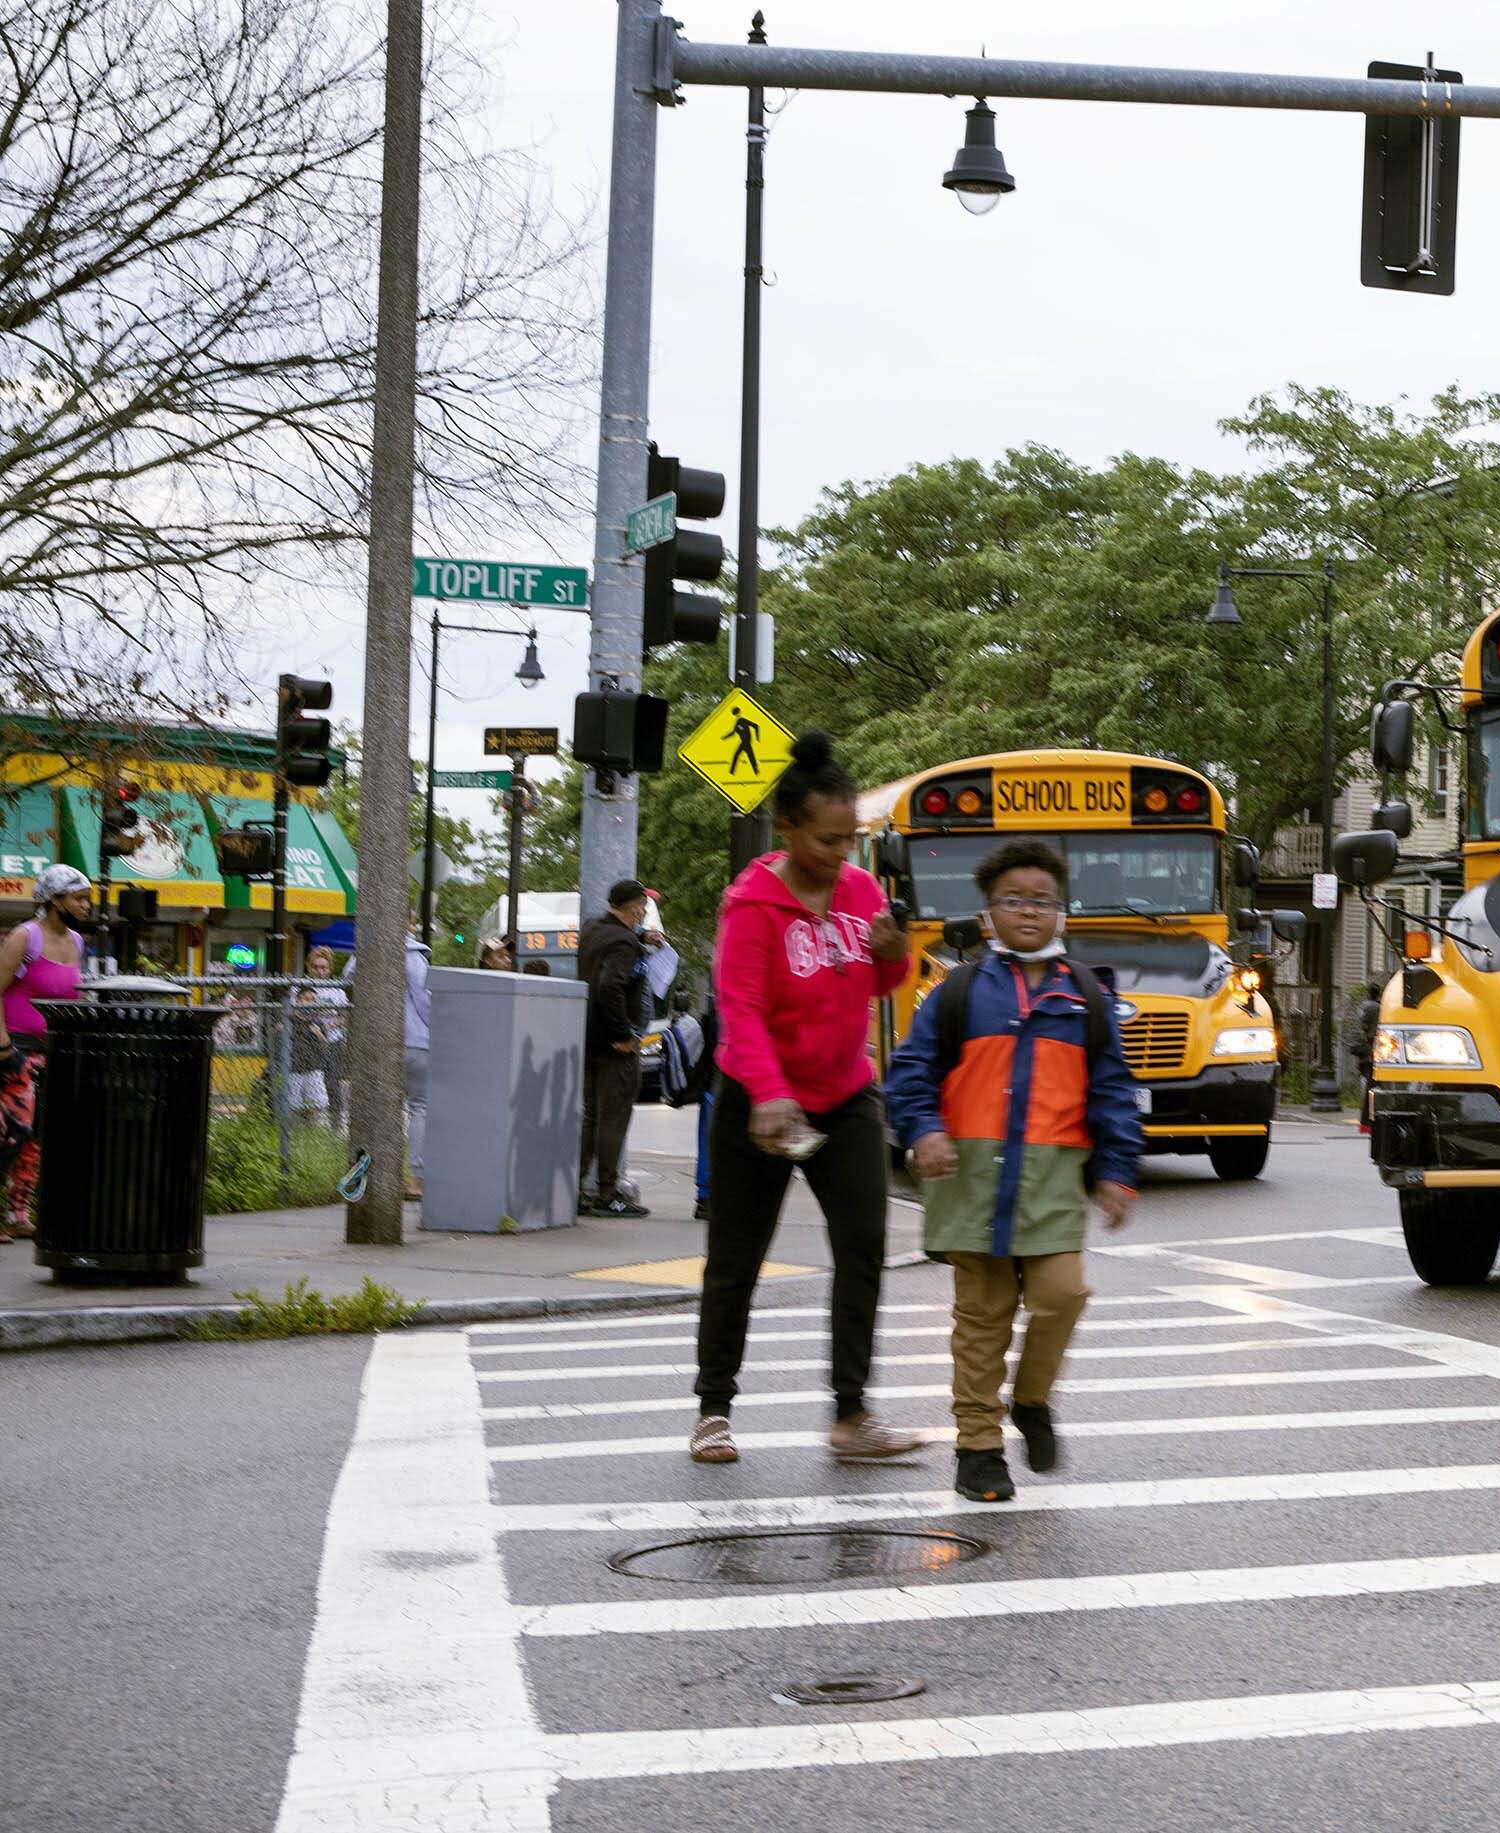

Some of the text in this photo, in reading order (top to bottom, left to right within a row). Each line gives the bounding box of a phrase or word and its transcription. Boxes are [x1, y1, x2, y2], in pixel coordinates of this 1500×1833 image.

[424, 562, 578, 603] TOPLIFF ST
[998, 780, 1126, 812] SCHOOL BUS
